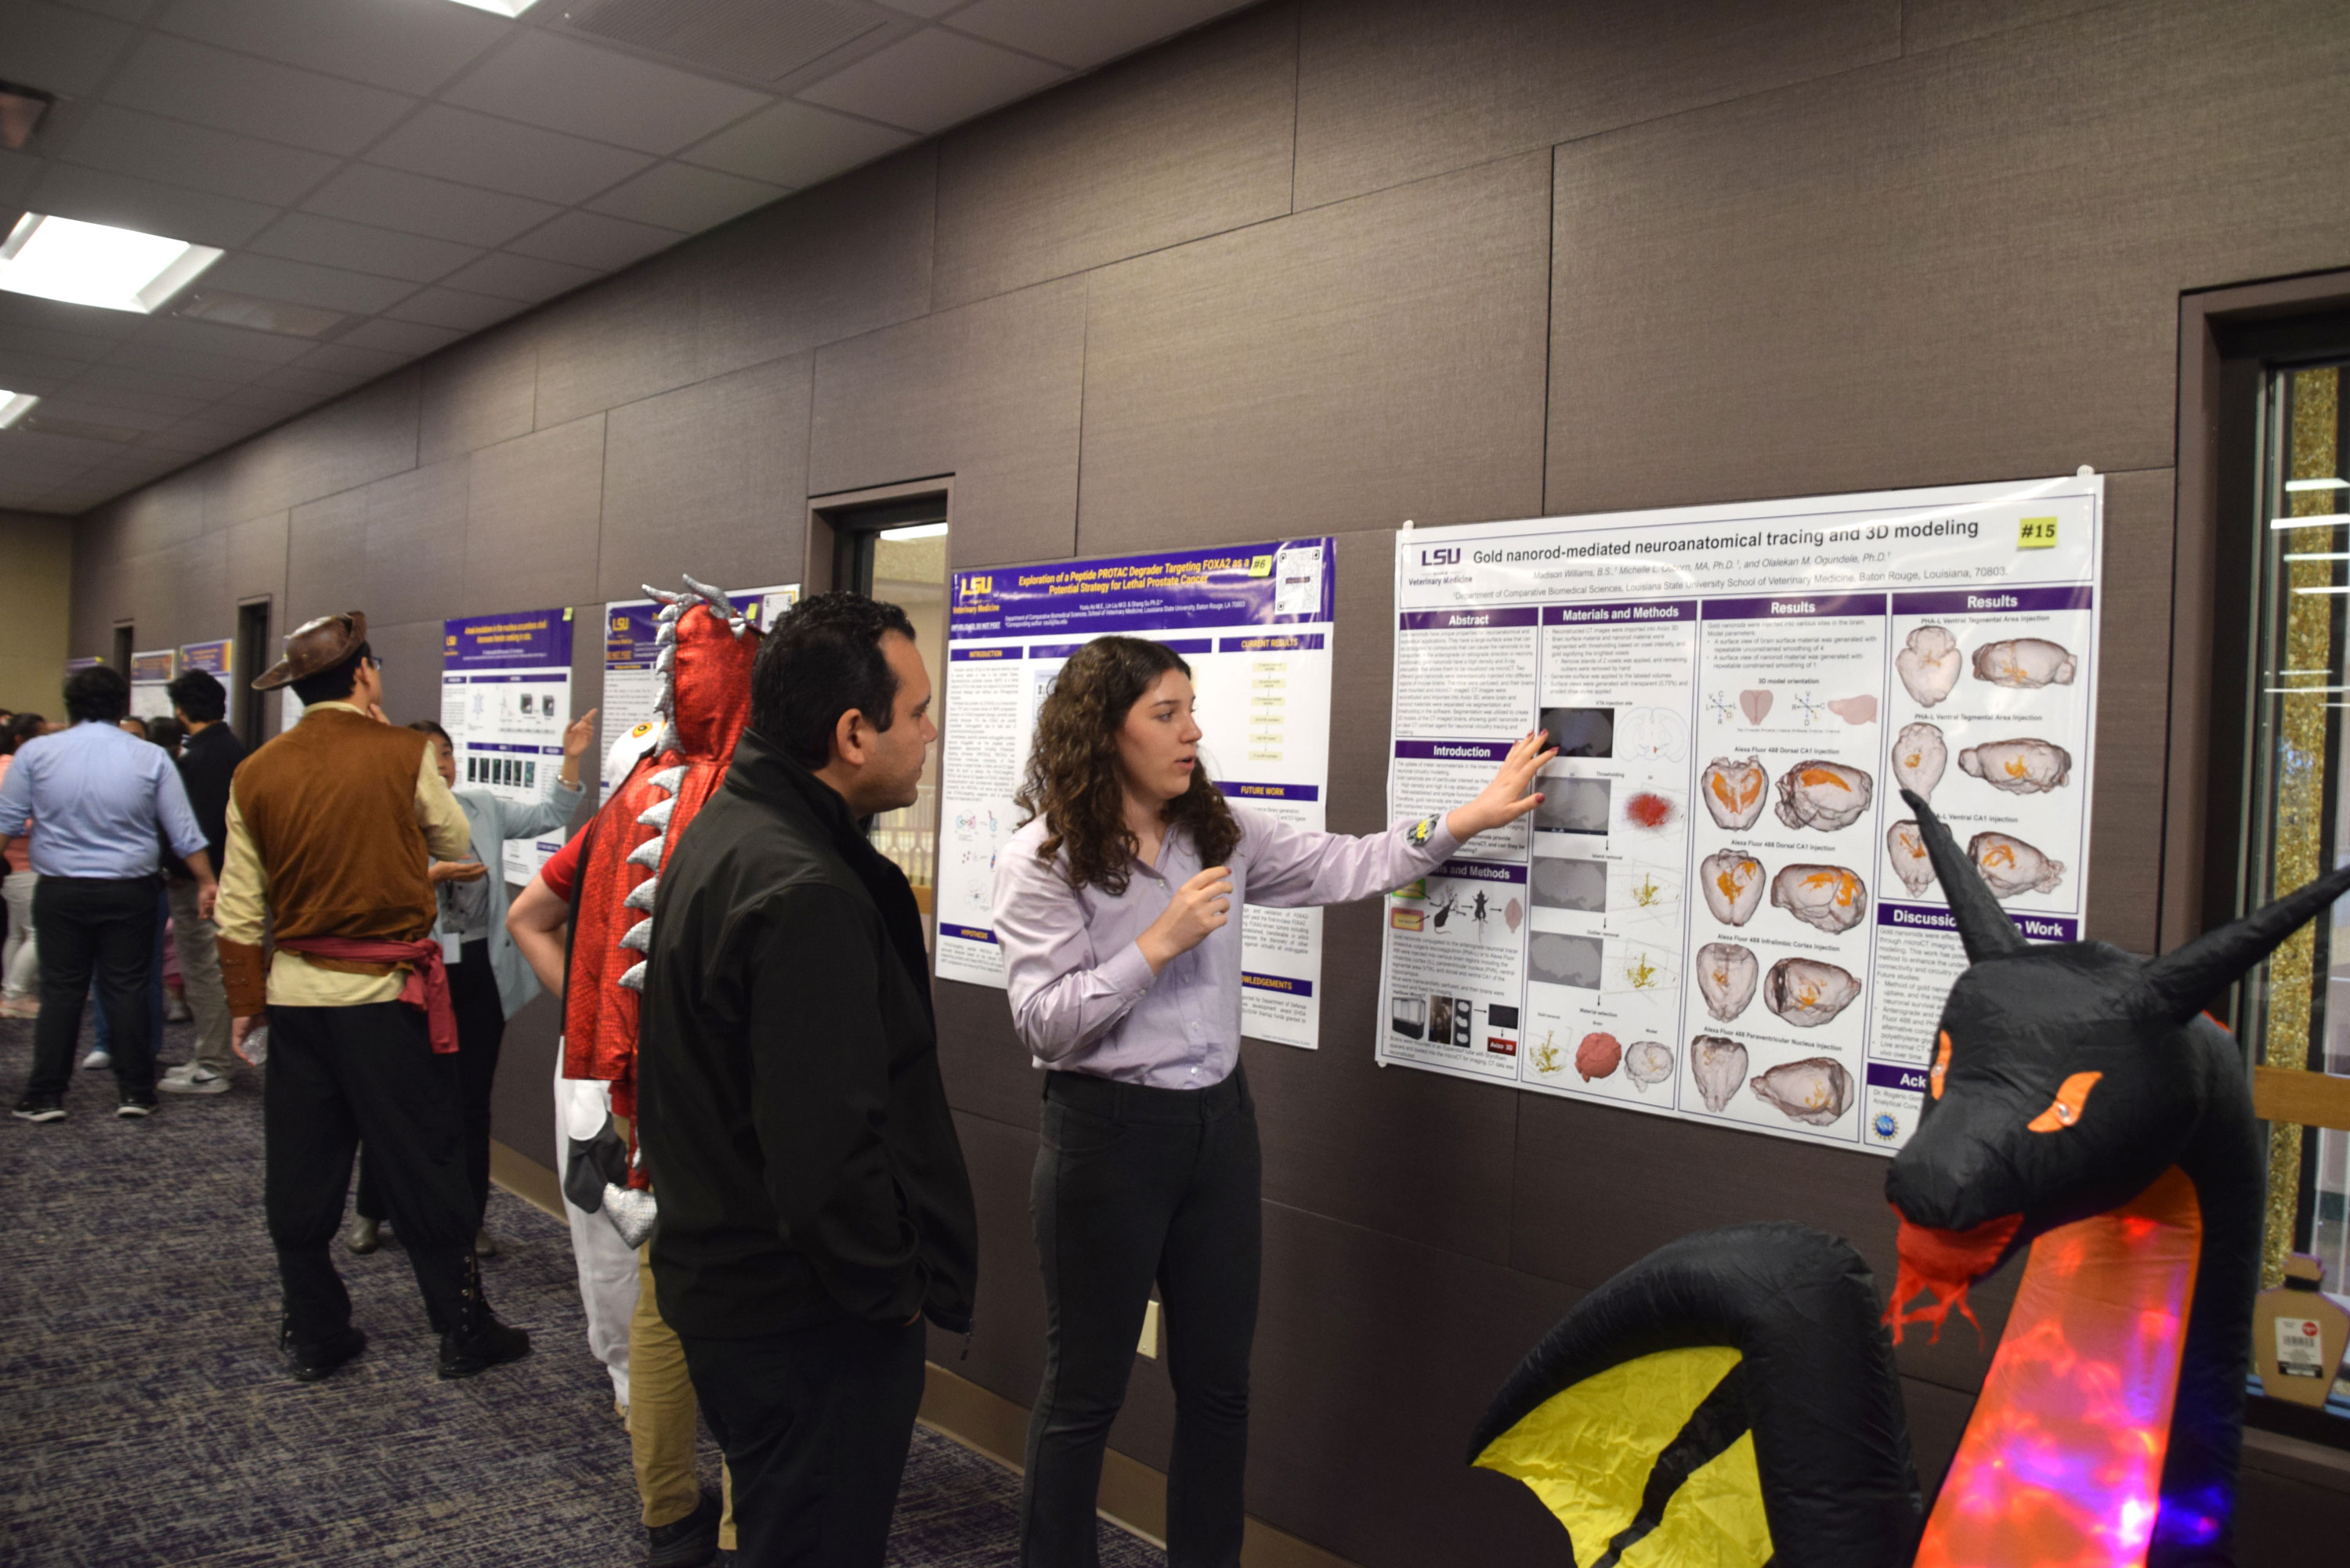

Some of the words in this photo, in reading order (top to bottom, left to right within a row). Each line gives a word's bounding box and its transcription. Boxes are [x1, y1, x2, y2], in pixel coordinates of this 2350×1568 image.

[2021, 524, 2055, 538] #15
[1473, 549, 1502, 564] Gold
[1506, 541, 1630, 562] nanorod-mediated
[1635, 533, 1762, 554] neuroanatomical
[1766, 531, 1824, 546] tracing
[1828, 527, 1860, 542] and
[1865, 526, 1889, 540] 3D
[1894, 522, 1978, 538] modeling
[1422, 548, 1461, 565] LSU
[1253, 559, 1266, 569] #6
[1018, 573, 1056, 587] Exploration
[1055, 573, 1064, 582] of
[1069, 570, 1097, 583] Peptide
[1097, 567, 1128, 579] PROTAC
[1128, 565, 1163, 578] Degrader
[1165, 562, 1201, 575] Targeting
[1202, 559, 1231, 570] FOXA2
[960, 576, 992, 595] LSU
[1047, 583, 1080, 594] Potential
[1079, 582, 1110, 593] Strategy
[1109, 581, 1122, 590] for
[1121, 579, 1146, 589] Lethal
[1146, 576, 1180, 587] Prostate
[1180, 576, 1209, 585] Cancer
[1770, 602, 1816, 614] Results
[1967, 595, 2018, 608] Results
[1563, 609, 1609, 620] Materials
[1611, 608, 1631, 619] and
[1632, 606, 1679, 619] Methods
[1448, 615, 1490, 626] Abstract
[1241, 639, 1270, 649] CURRENT
[1269, 638, 1298, 647] RESULTS
[1433, 746, 1491, 757] Introduction
[1240, 786, 1265, 795] FUTURE
[1264, 787, 1285, 796] WORK
[1450, 866, 1467, 876] and
[1470, 867, 1510, 880] Methods
[2025, 922, 2063, 936] Work
[1242, 976, 1292, 989] WLEDGEMENTS
